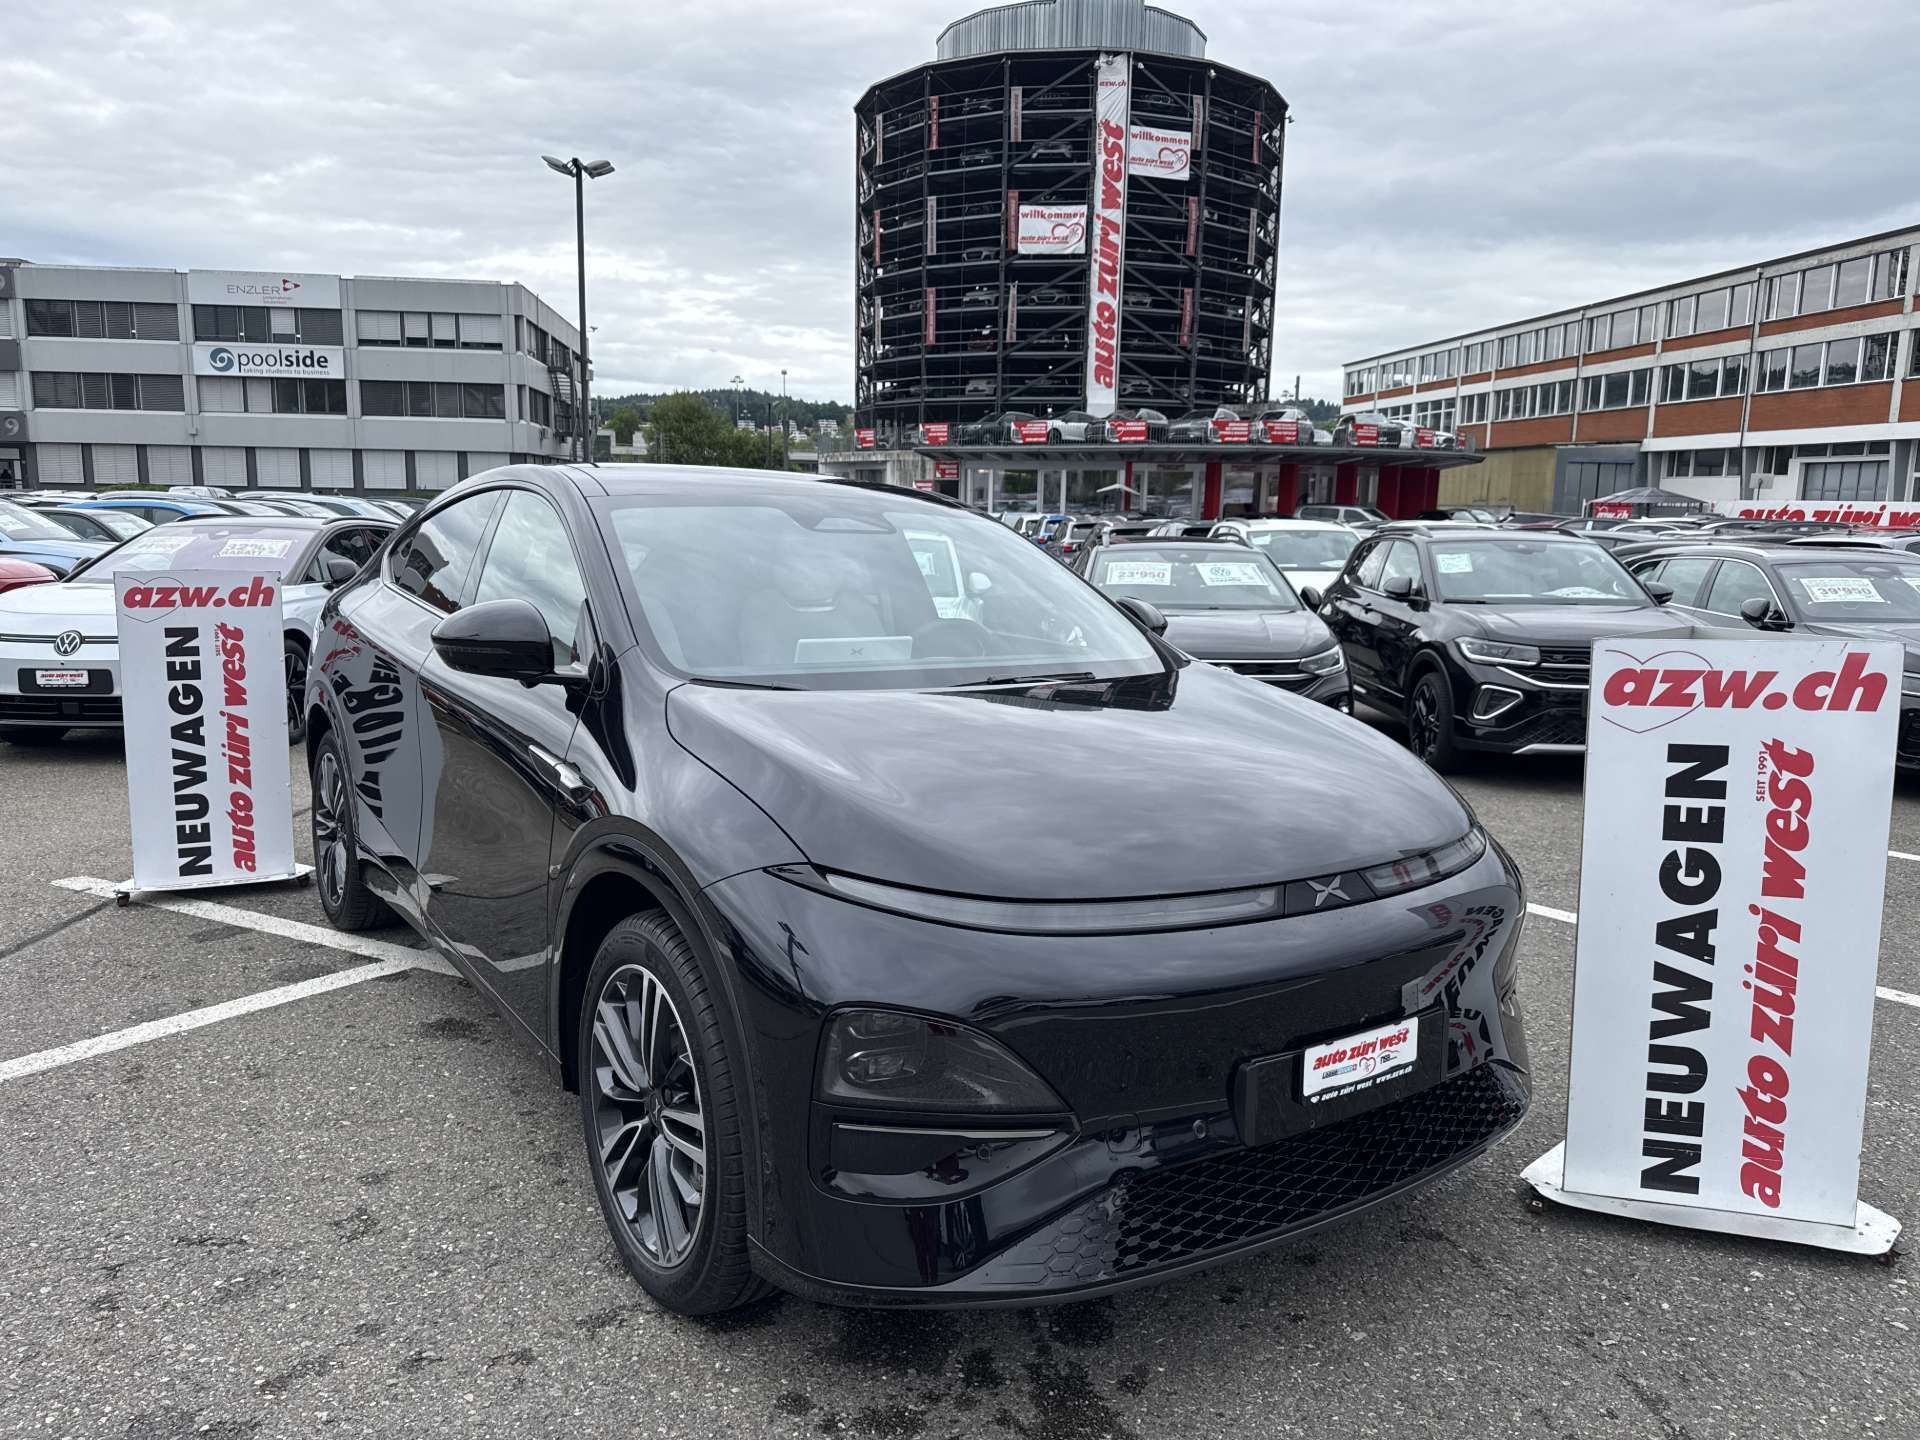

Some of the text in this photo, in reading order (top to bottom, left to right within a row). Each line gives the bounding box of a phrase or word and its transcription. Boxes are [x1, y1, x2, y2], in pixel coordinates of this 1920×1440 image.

[1131, 131, 1189, 145] willkommen
[1021, 210, 1085, 219] willkommen
[1092, 118, 1124, 389] auto züri west
[226, 284, 281, 295] ENZLER
[237, 348, 329, 373] poolside
[243, 367, 264, 375] taking
[302, 368, 330, 376] business
[4, 417, 20, 436] 9
[1738, 504, 1806, 521] auto
[123, 576, 275, 608] azw.ch
[1603, 652, 1888, 713] azw.ch
[164, 626, 213, 877] NEUWAGEN
[214, 622, 257, 873] auto züri west
[1755, 750, 1768, 803] SEIT 1991
[1640, 743, 1731, 1195] NEUWAGEN
[1735, 737, 1816, 1209] auto züri west
[1313, 1049, 1347, 1070] auto
[1347, 1037, 1379, 1060] züri
[1379, 1027, 1409, 1050] west
[1321, 1090, 1339, 1101] auto
